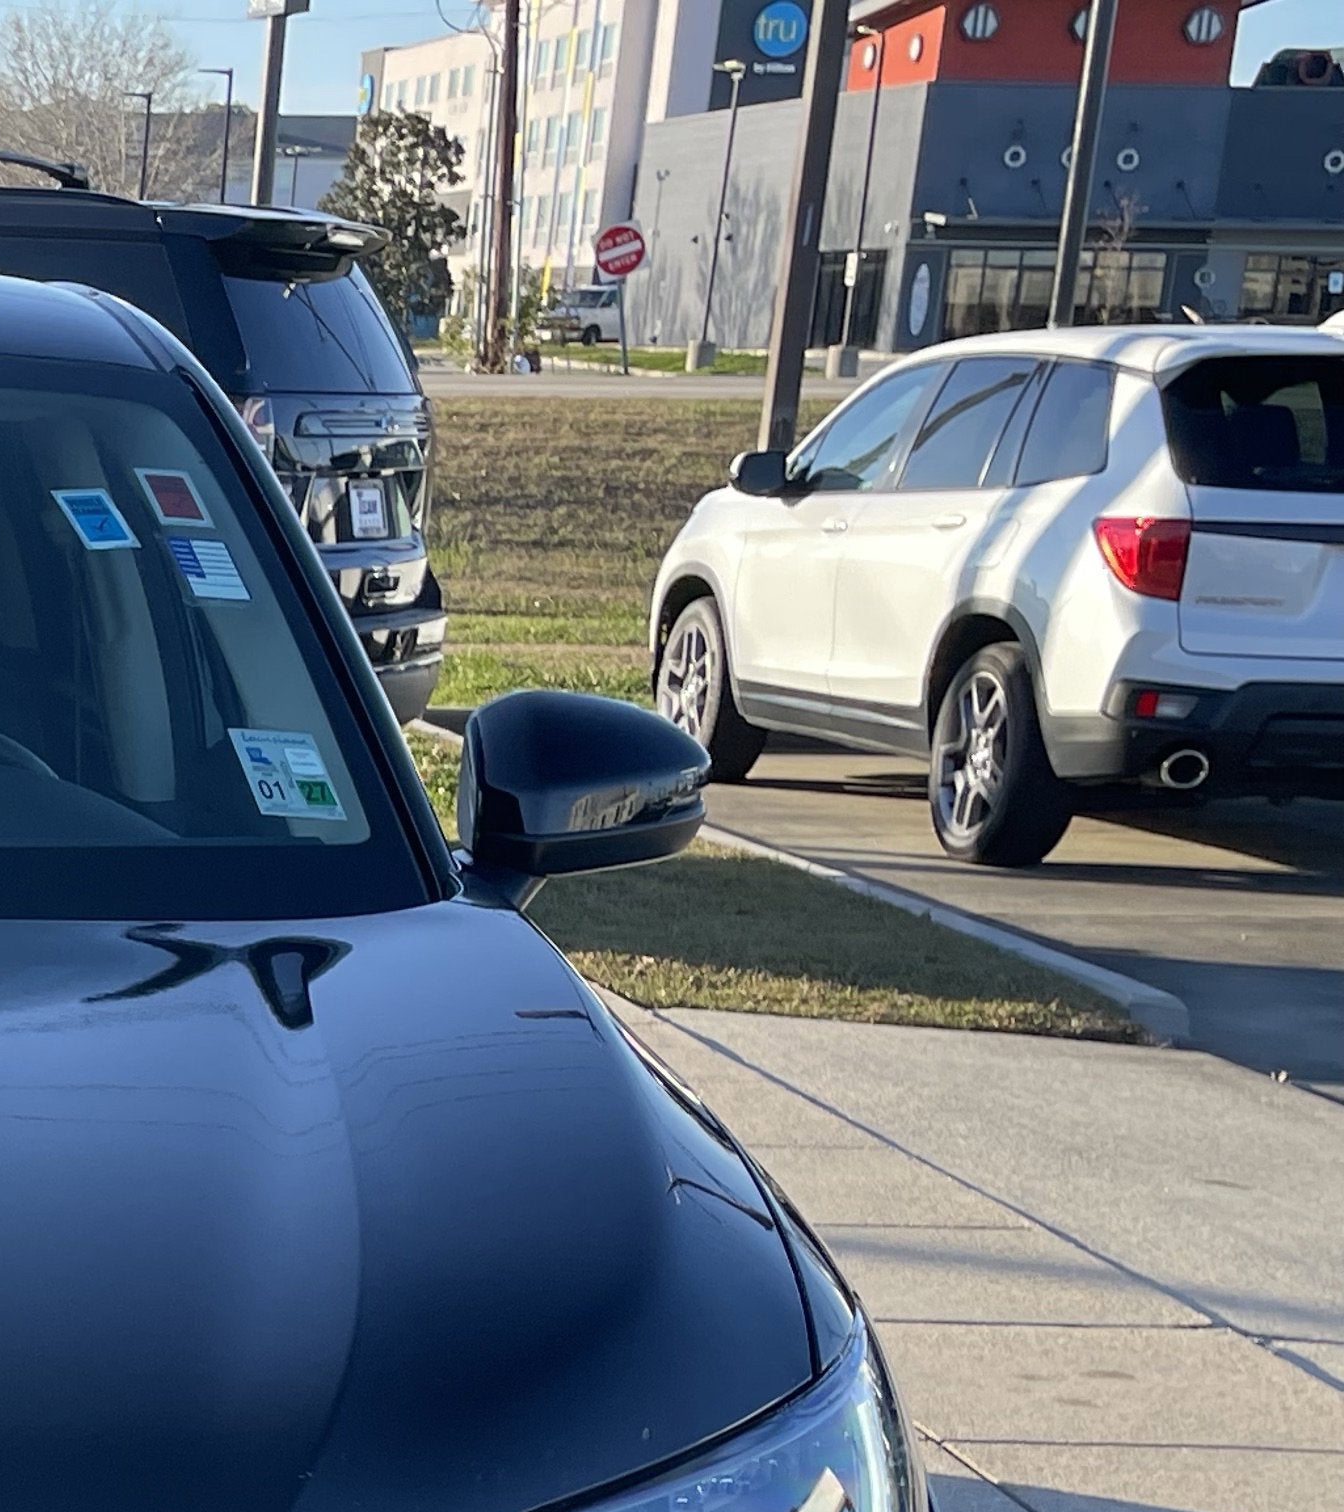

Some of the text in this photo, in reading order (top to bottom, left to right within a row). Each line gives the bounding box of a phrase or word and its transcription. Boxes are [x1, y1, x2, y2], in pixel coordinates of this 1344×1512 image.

[756, 14, 797, 42] tru
[607, 254, 638, 272] ENTER
[257, 779, 287, 802] 01
